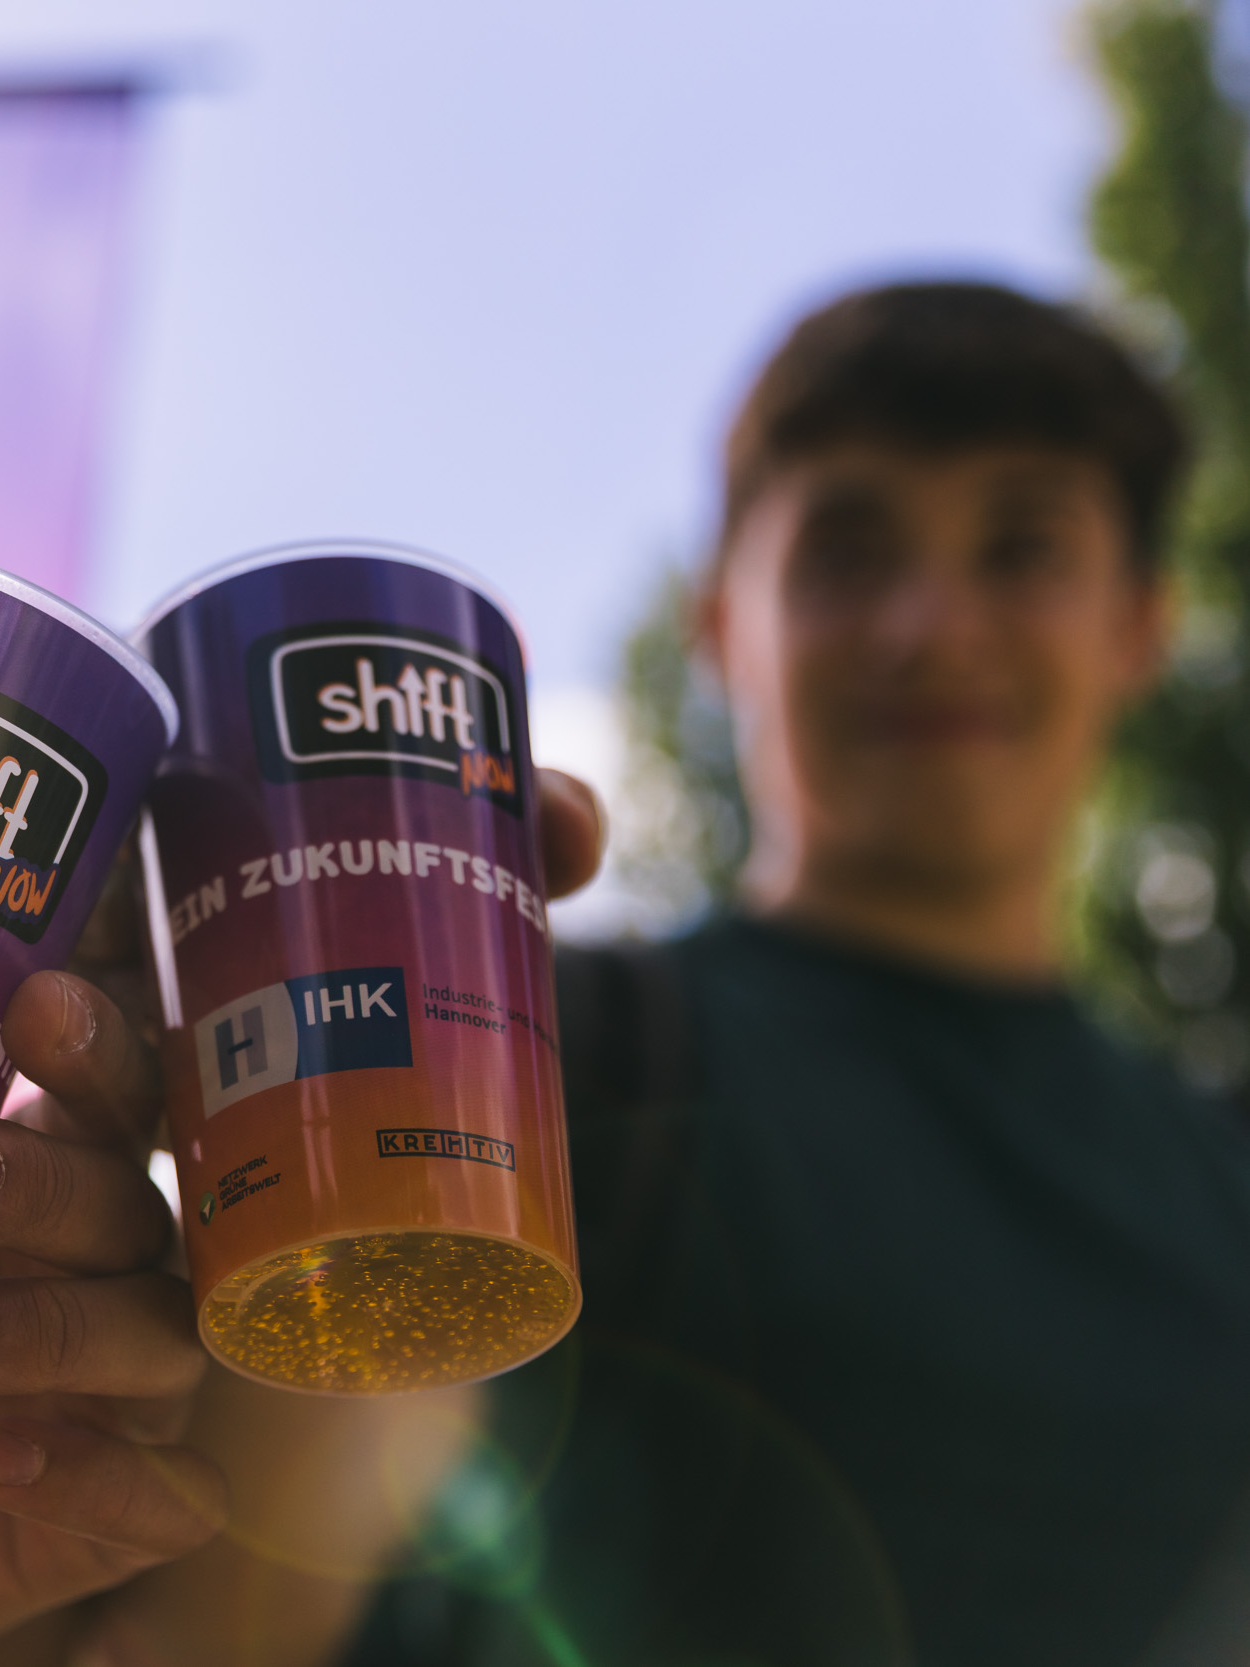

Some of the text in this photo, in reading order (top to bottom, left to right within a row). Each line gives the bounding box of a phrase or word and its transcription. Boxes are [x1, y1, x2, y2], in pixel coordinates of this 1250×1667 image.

[318, 657, 475, 750] shift
[461, 751, 516, 796] NOW
[423, 983, 503, 1013] Industrie-
[214, 982, 397, 1091] H IHK
[424, 1003, 506, 1035] Hannover
[218, 1154, 268, 1190] NETZWERK
